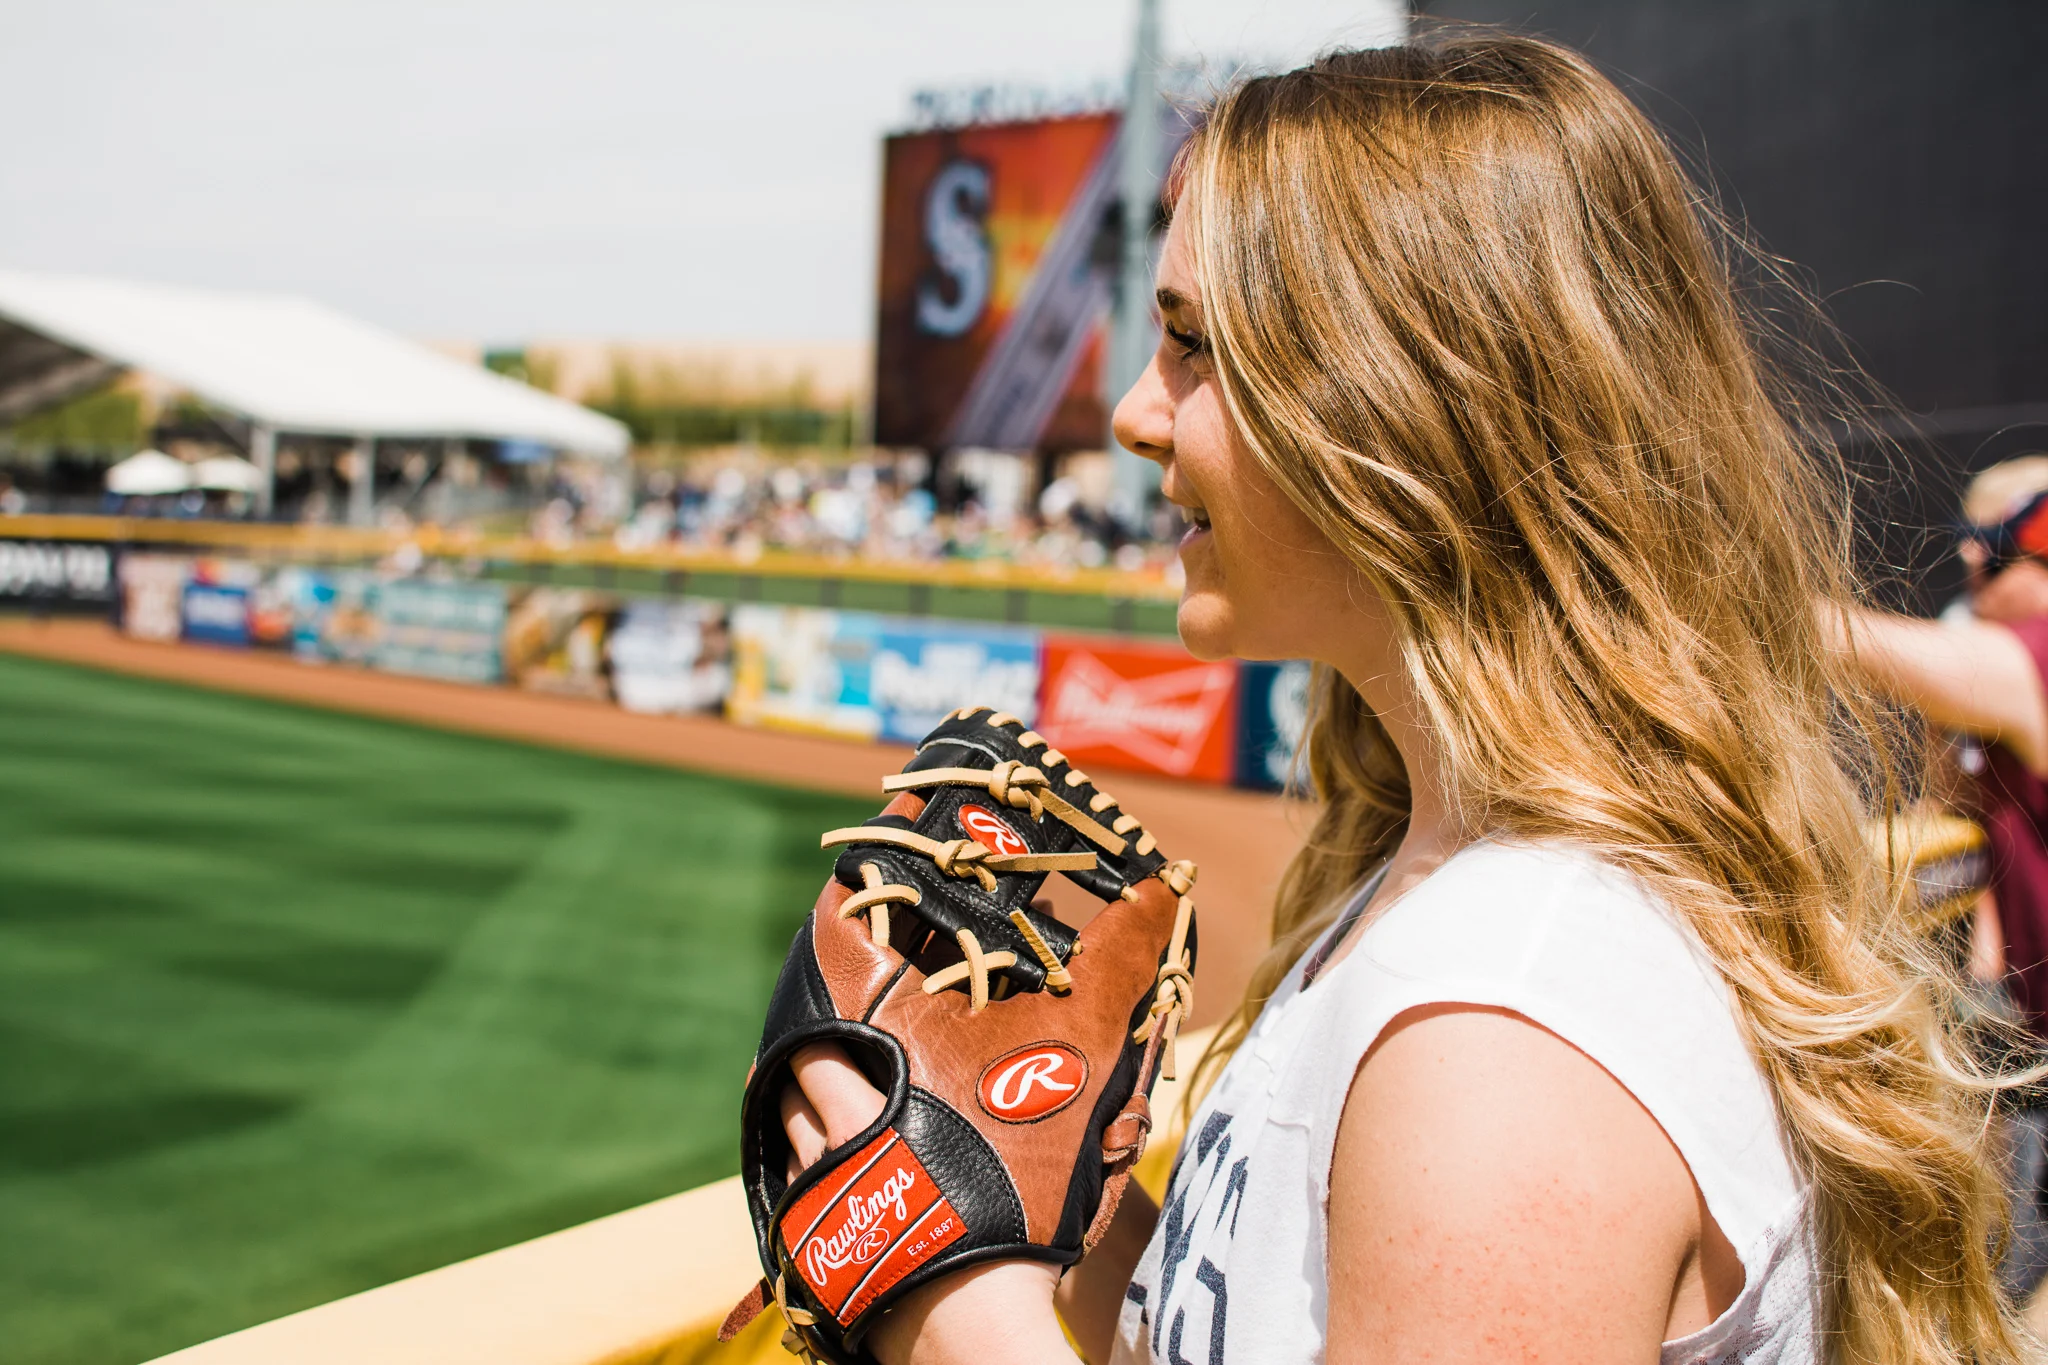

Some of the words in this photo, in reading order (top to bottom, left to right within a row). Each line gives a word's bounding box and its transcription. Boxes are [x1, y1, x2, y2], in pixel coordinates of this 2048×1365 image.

[967, 811, 1021, 855] R
[990, 1053, 1076, 1110] R
[805, 1167, 915, 1287] Rawlings
[856, 1232, 883, 1261] R
[906, 1239, 930, 1257] Est.
[928, 1217, 954, 1241] 1887
